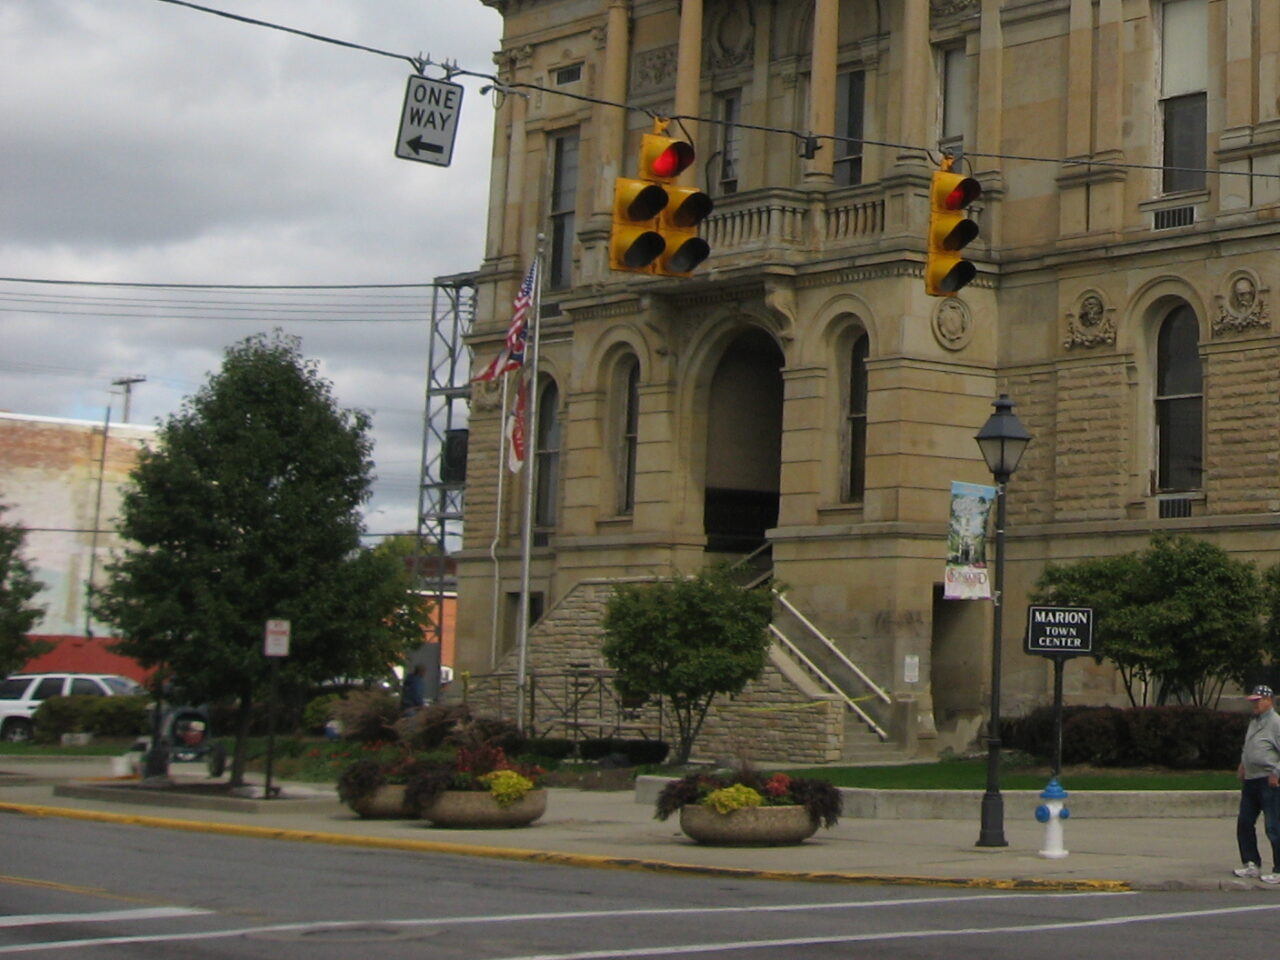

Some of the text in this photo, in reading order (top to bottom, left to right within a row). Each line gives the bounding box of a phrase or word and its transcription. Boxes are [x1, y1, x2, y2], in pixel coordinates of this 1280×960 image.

[414, 83, 457, 110] ONE
[410, 106, 452, 132] WAY
[1034, 611, 1088, 624] MARION
[1045, 626, 1077, 636] TOWN
[1038, 637, 1082, 647] CENTER
